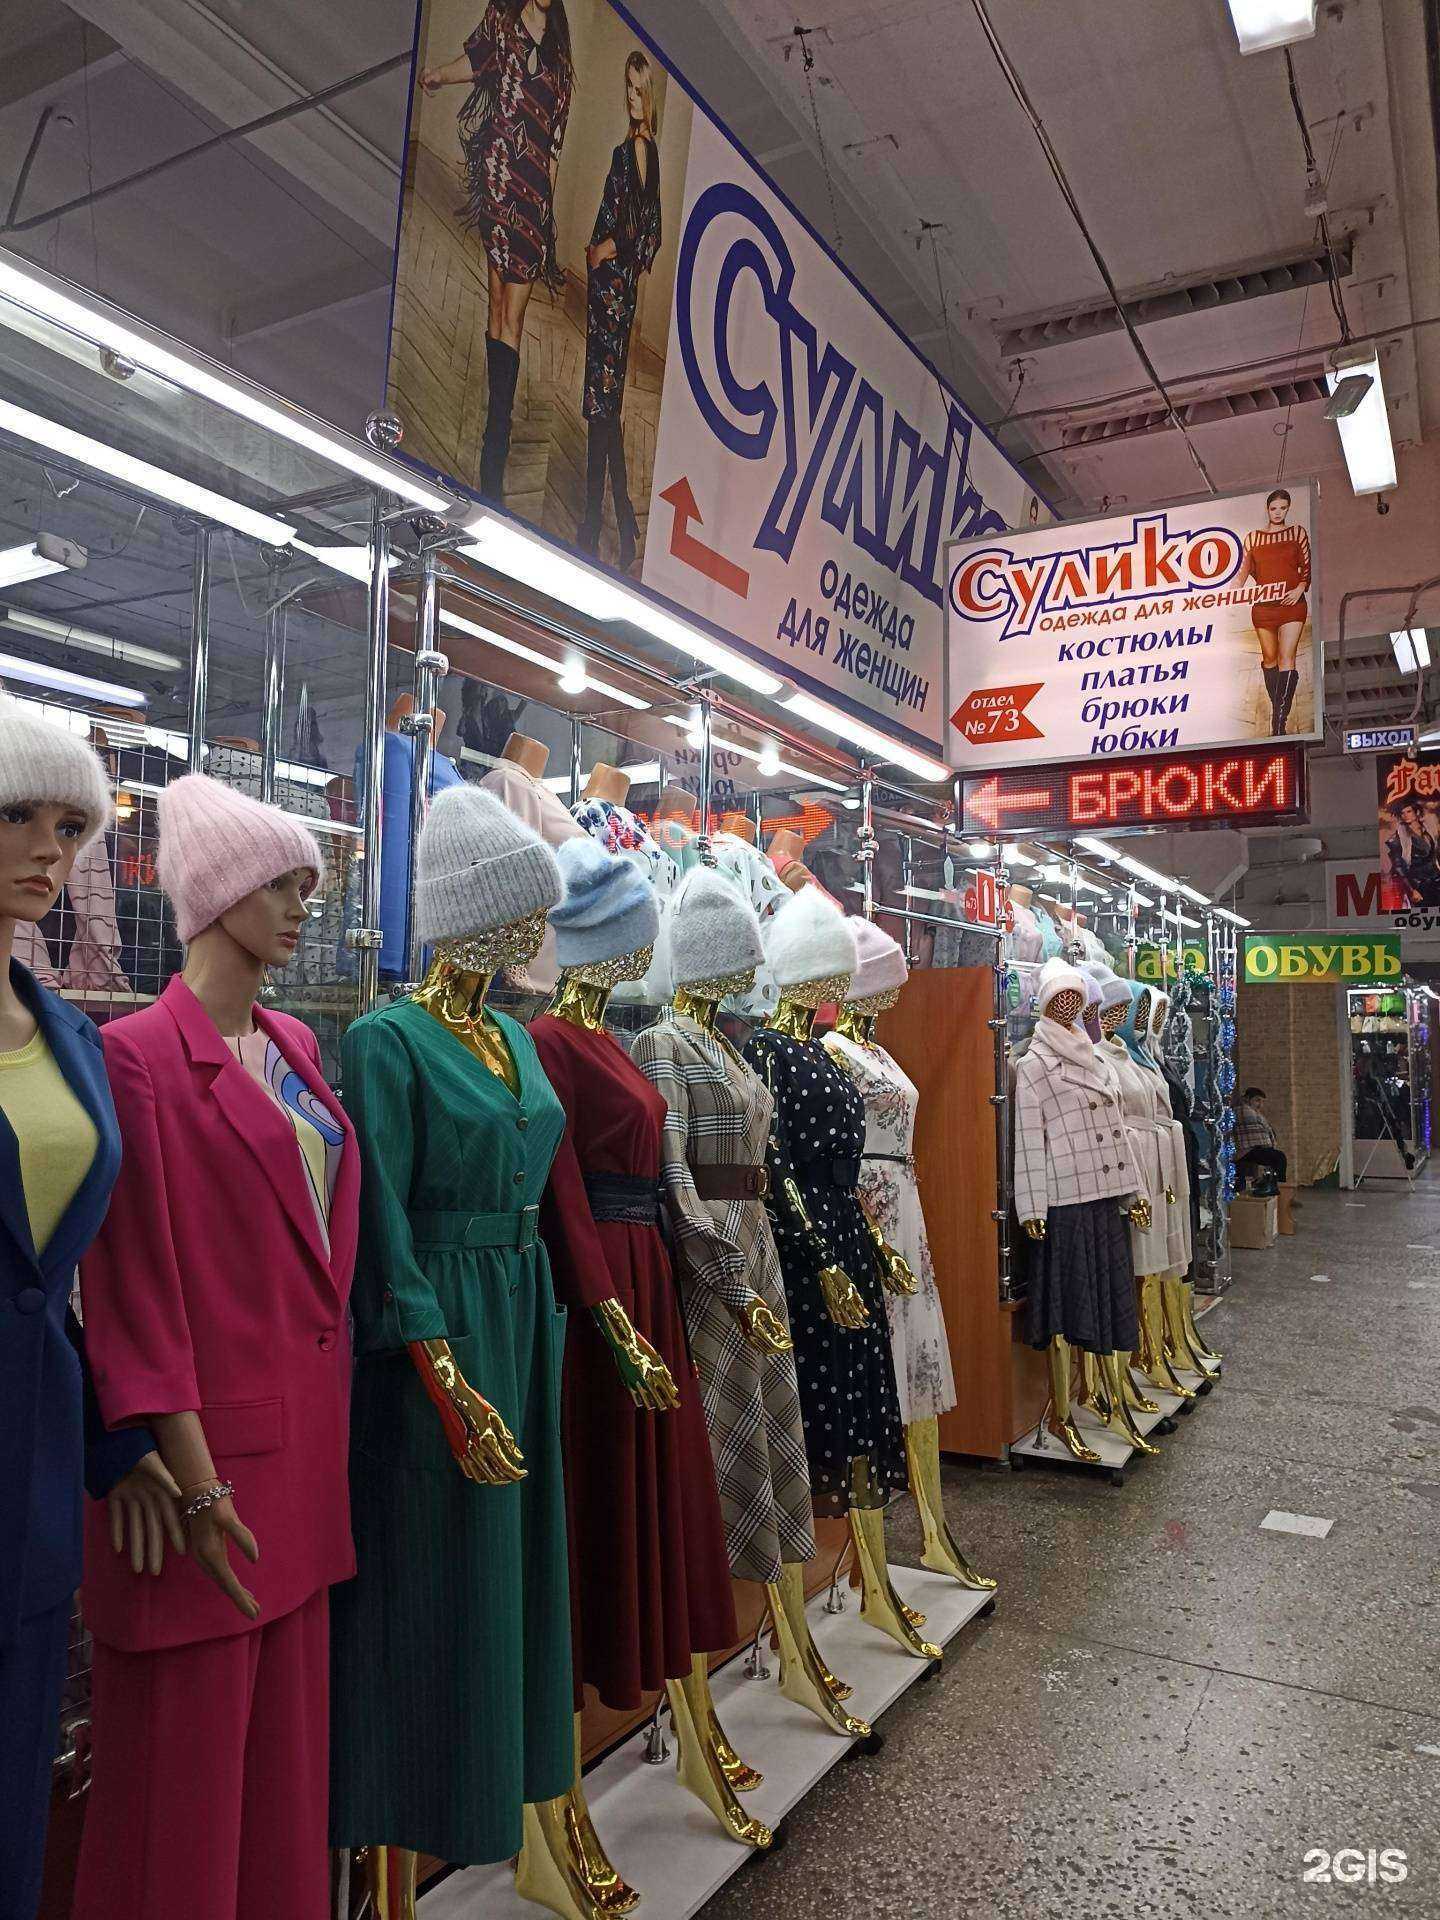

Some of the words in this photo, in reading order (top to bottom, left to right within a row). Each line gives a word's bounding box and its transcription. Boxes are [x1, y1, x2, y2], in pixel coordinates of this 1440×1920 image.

[949, 514, 1243, 640] Сулико
[820, 559, 915, 651] одежда
[1039, 606, 1127, 632] одежда
[1134, 601, 1173, 621] для
[1182, 581, 1286, 611] женщин
[776, 597, 830, 656] для
[832, 628, 930, 712] женщин
[1058, 624, 1214, 662] костюмы
[1080, 660, 1189, 691] платья
[970, 694, 1015, 710] отдел
[1081, 693, 1189, 729] брюки
[965, 708, 1021, 736] №73
[1091, 724, 1180, 754] юбки
[1351, 730, 1411, 748] ВЫХОД
[1071, 757, 1286, 821] БРЮКИ
[1245, 944, 1402, 977] ОБУВЬ
